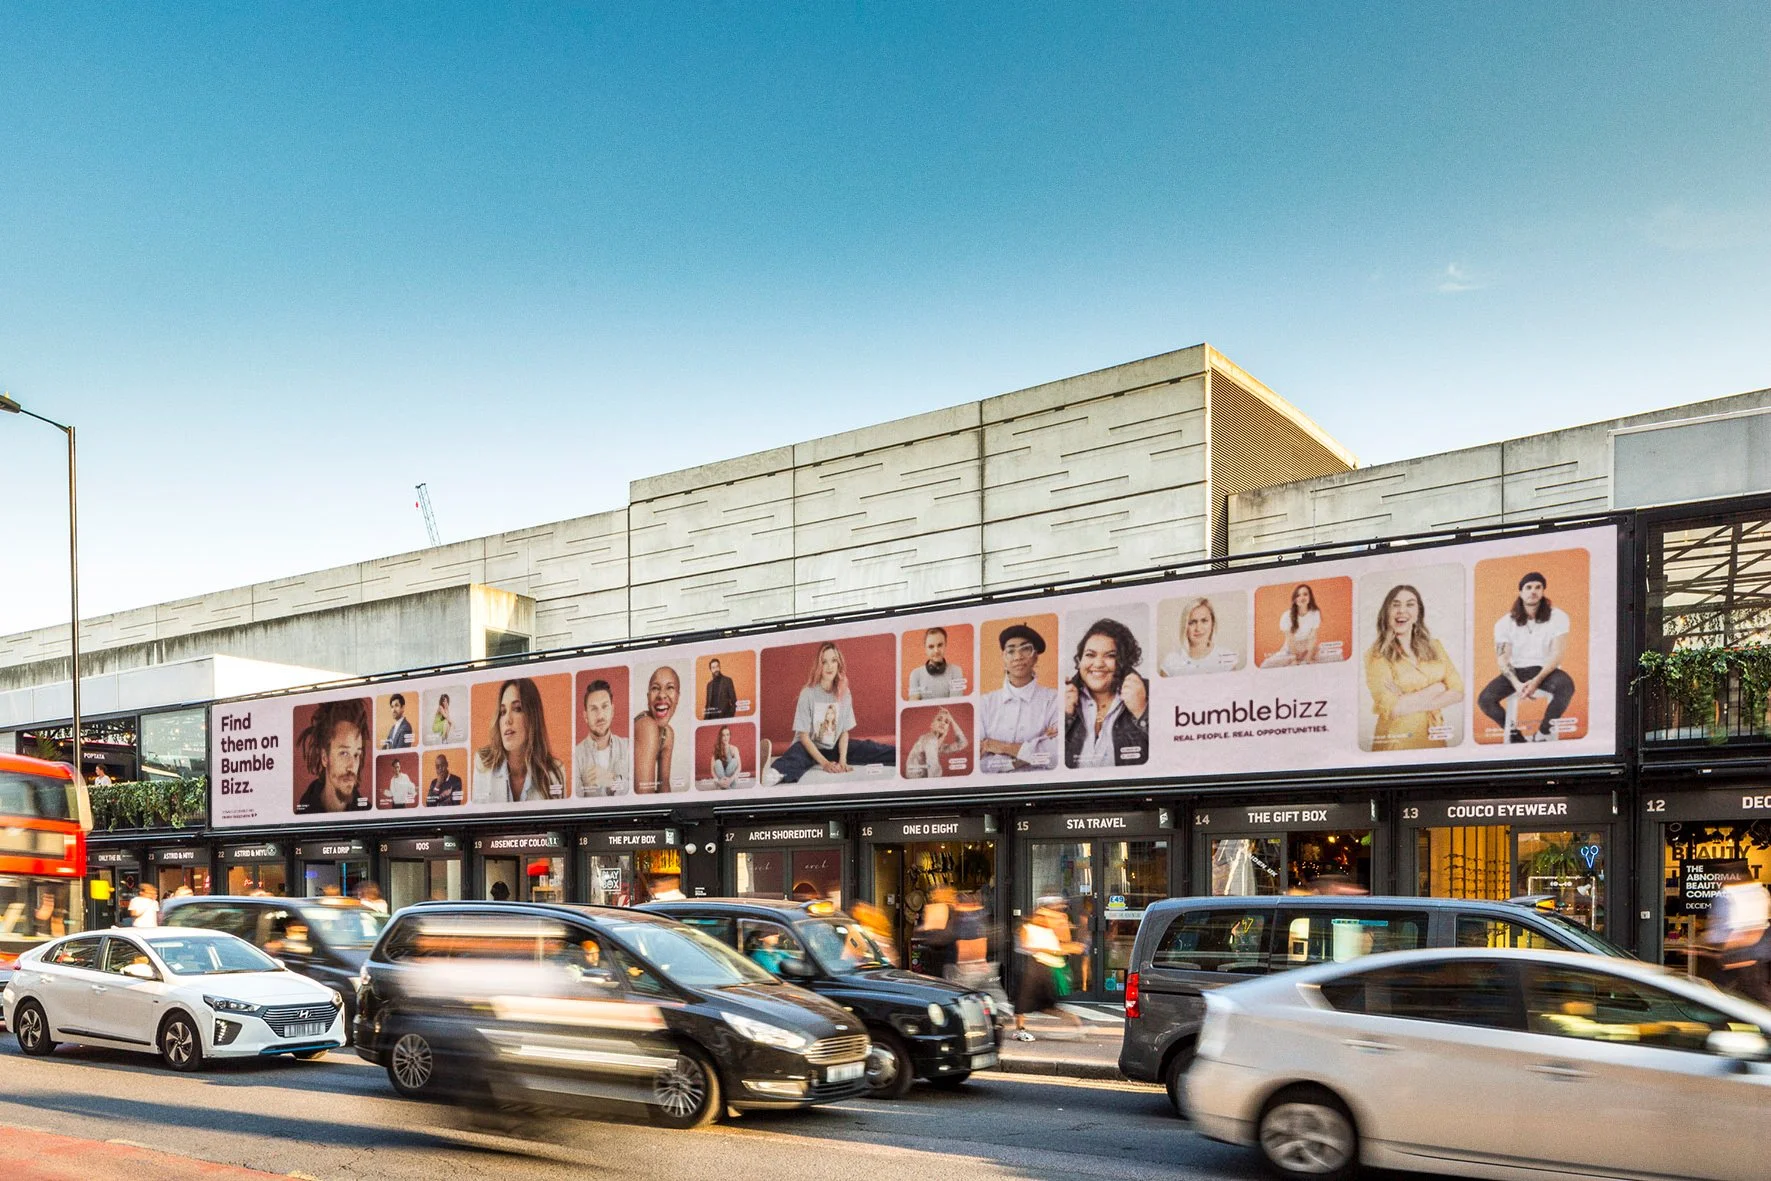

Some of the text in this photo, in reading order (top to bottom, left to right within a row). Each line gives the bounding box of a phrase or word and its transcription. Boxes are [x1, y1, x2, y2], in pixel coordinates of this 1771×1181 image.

[222, 712, 251, 732] Find
[221, 735, 278, 752] them on
[222, 754, 274, 774] Bumble
[222, 779, 253, 794] Bizz.
[1448, 803, 1567, 818] COUCO EYEWEAR
[1646, 800, 1666, 812] 12
[1248, 810, 1327, 823] THE GIFT BOX
[1403, 808, 1418, 819] 13
[1066, 818, 1126, 829] STA TRAVEL
[1196, 815, 1210, 825] 14
[862, 827, 872, 836] 16
[903, 825, 920, 834] ONE
[932, 824, 958, 834] EIGHT
[1017, 822, 1028, 831] 15
[609, 836, 622, 844] THE
[623, 836, 640, 844] PLAY
[641, 835, 656, 844] BOX
[725, 833, 734, 841] 17
[749, 829, 823, 840] ARCH SHOREDITCH
[491, 840, 518, 848] ABSENCE
[519, 839, 528, 847] OF
[579, 837, 587, 845] 18
[337, 846, 349, 854] DRIP
[1686, 865, 1704, 873] THE
[1686, 873, 1741, 881] ABNORMAL
[1686, 882, 1722, 890] BEAUTY
